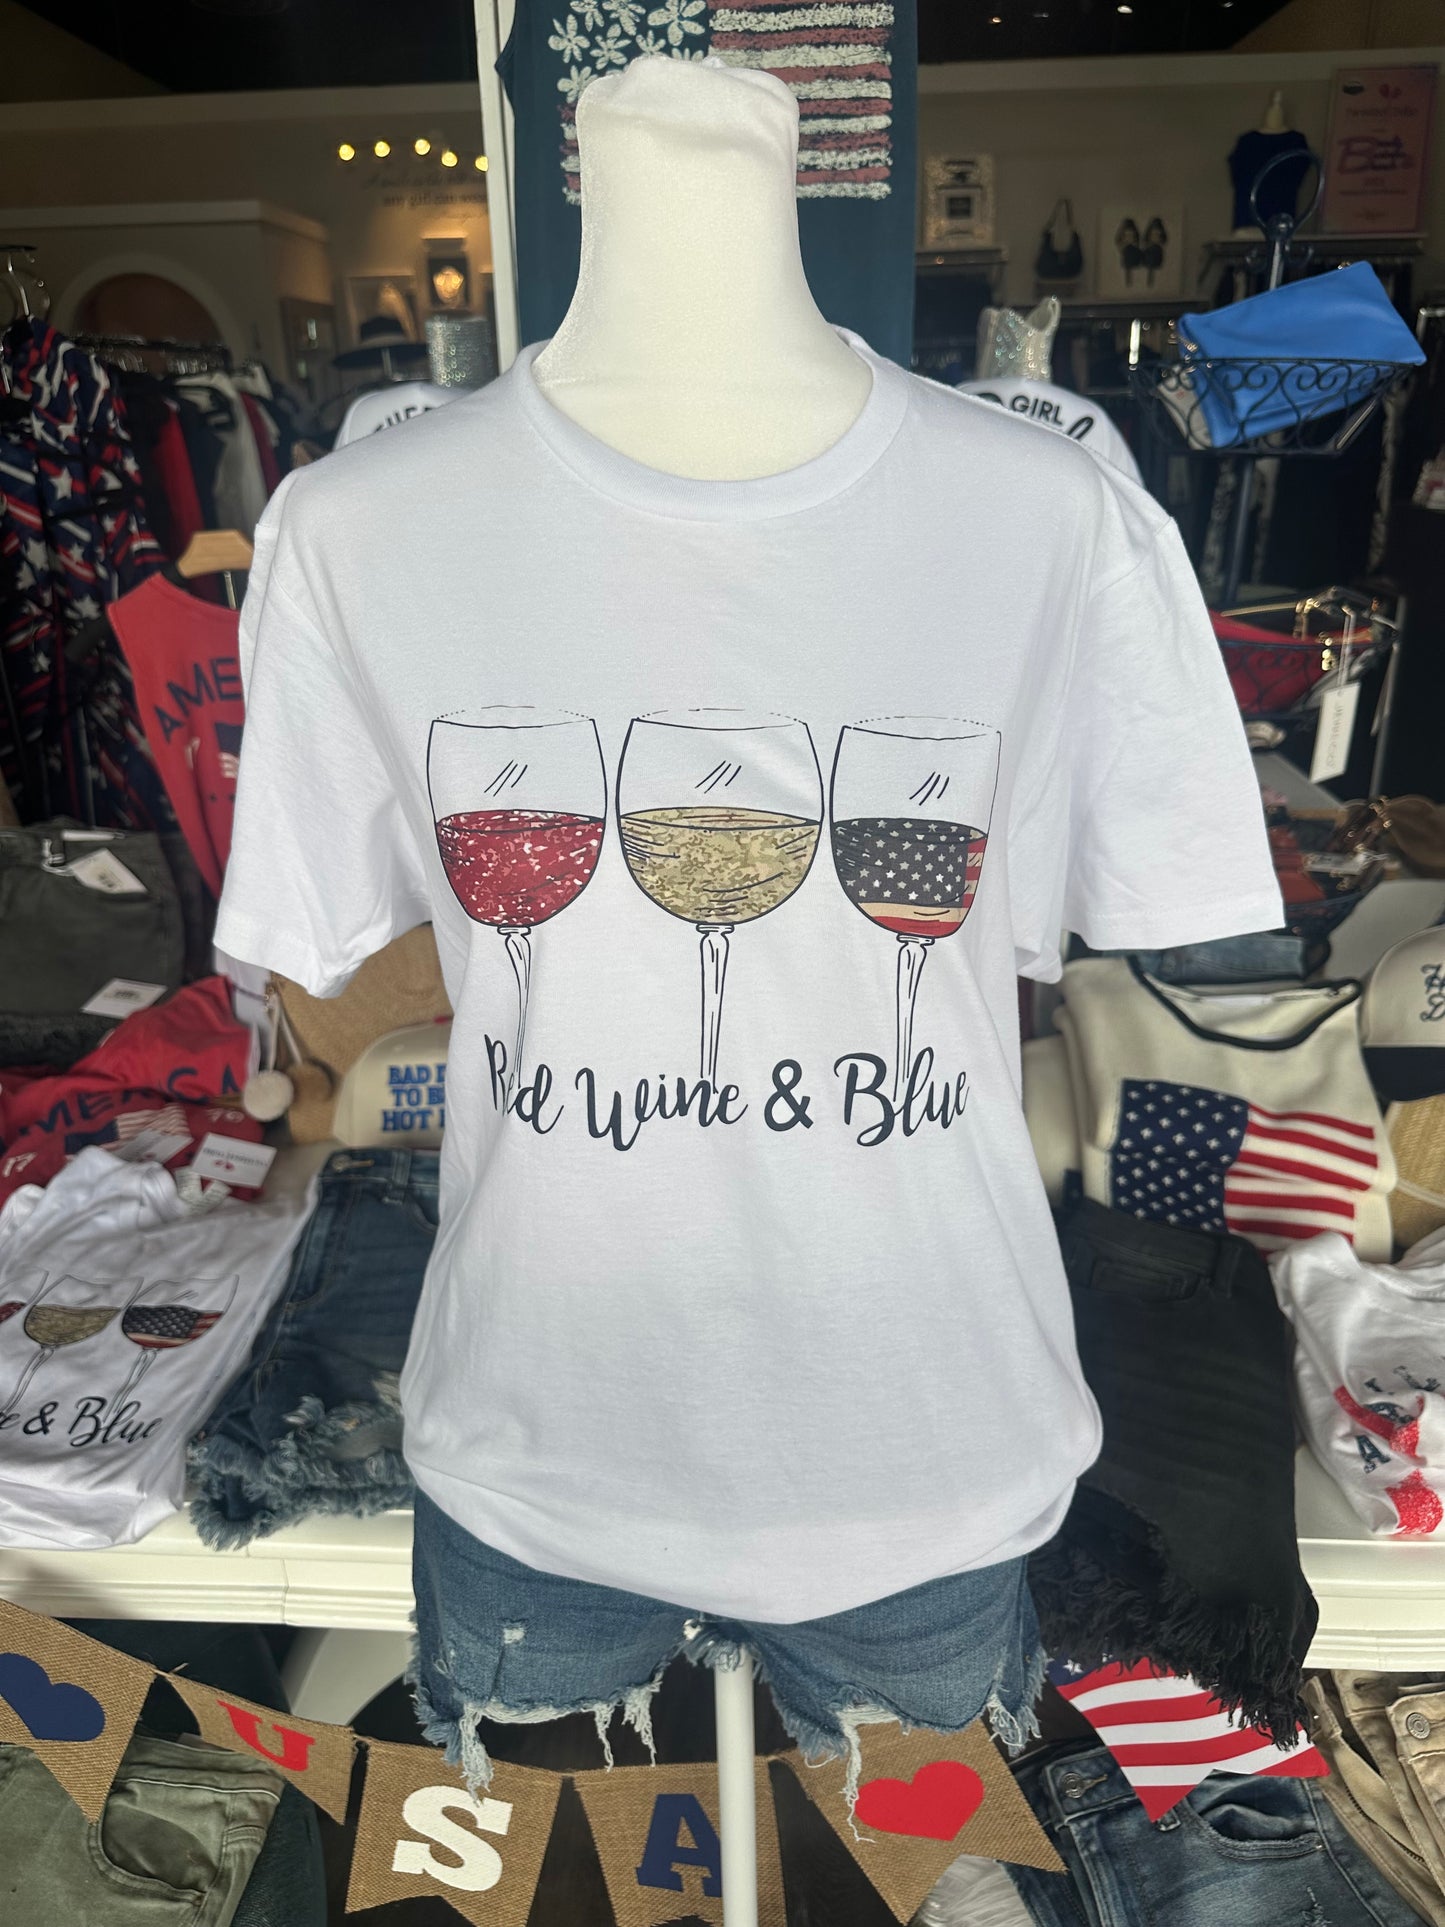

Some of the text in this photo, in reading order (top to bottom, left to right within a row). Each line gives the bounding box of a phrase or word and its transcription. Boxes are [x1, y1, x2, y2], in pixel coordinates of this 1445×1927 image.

[1011, 394, 1063, 426] GIRL
[387, 1064, 431, 1085] BAD
[390, 1085, 446, 1107] TO B
[484, 1033, 970, 1152] Red Wine & Blue
[382, 1109, 432, 1132] HOT
[23, 1401, 59, 1436] &
[69, 1396, 164, 1447] Blue
